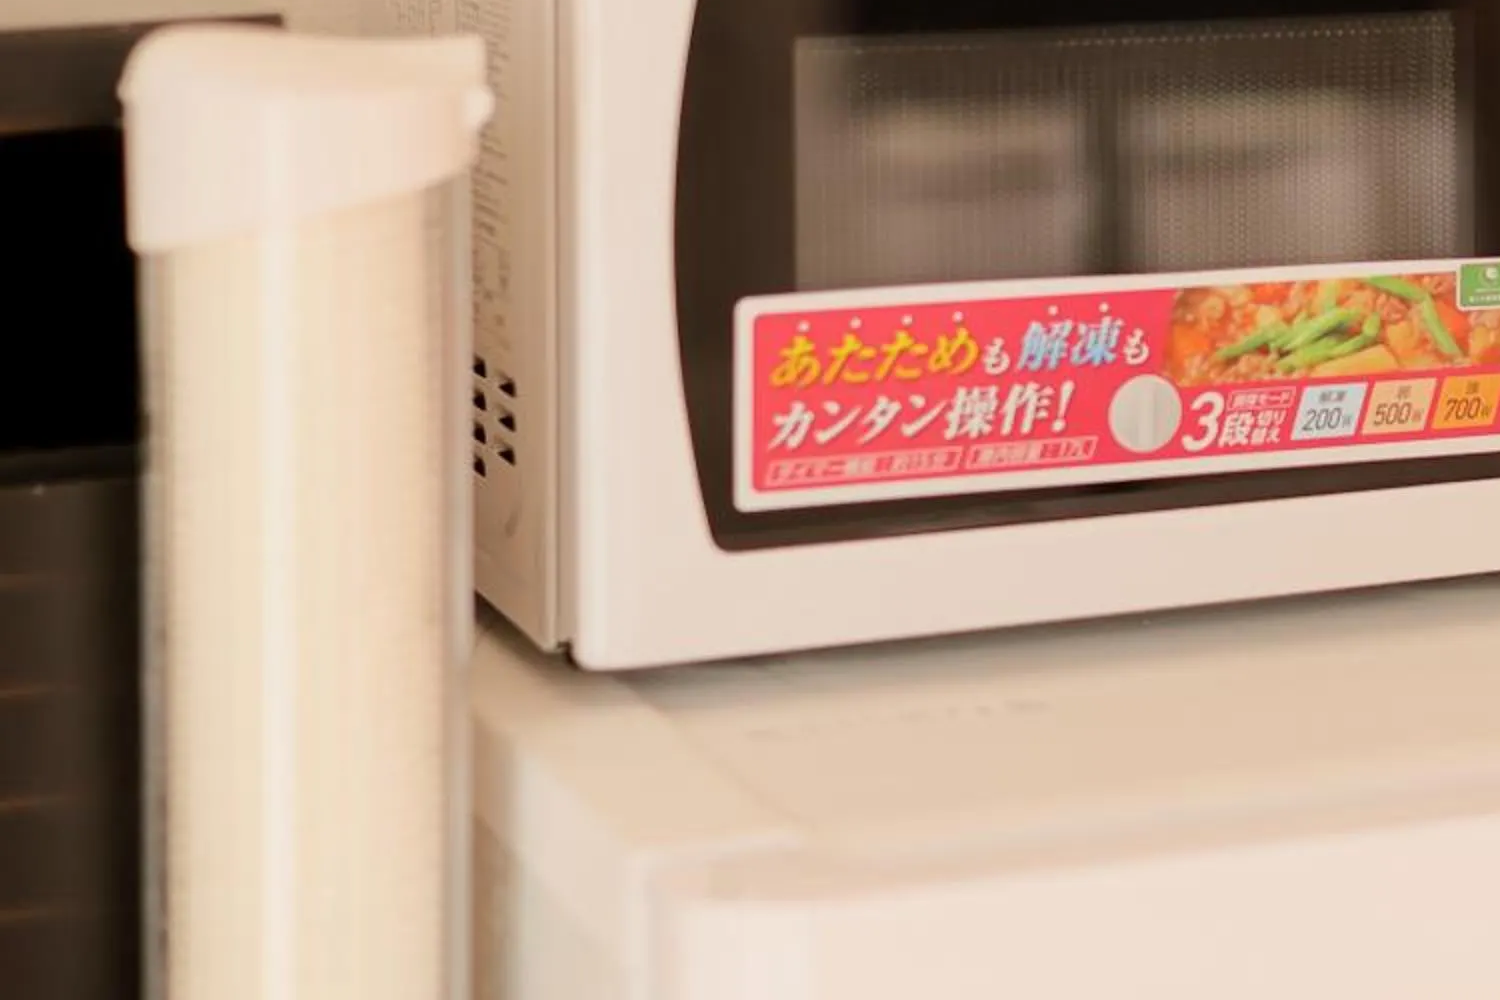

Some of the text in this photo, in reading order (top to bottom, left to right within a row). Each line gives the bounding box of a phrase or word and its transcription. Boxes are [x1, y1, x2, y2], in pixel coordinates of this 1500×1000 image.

[771, 318, 1150, 387] あたためも解凍も
